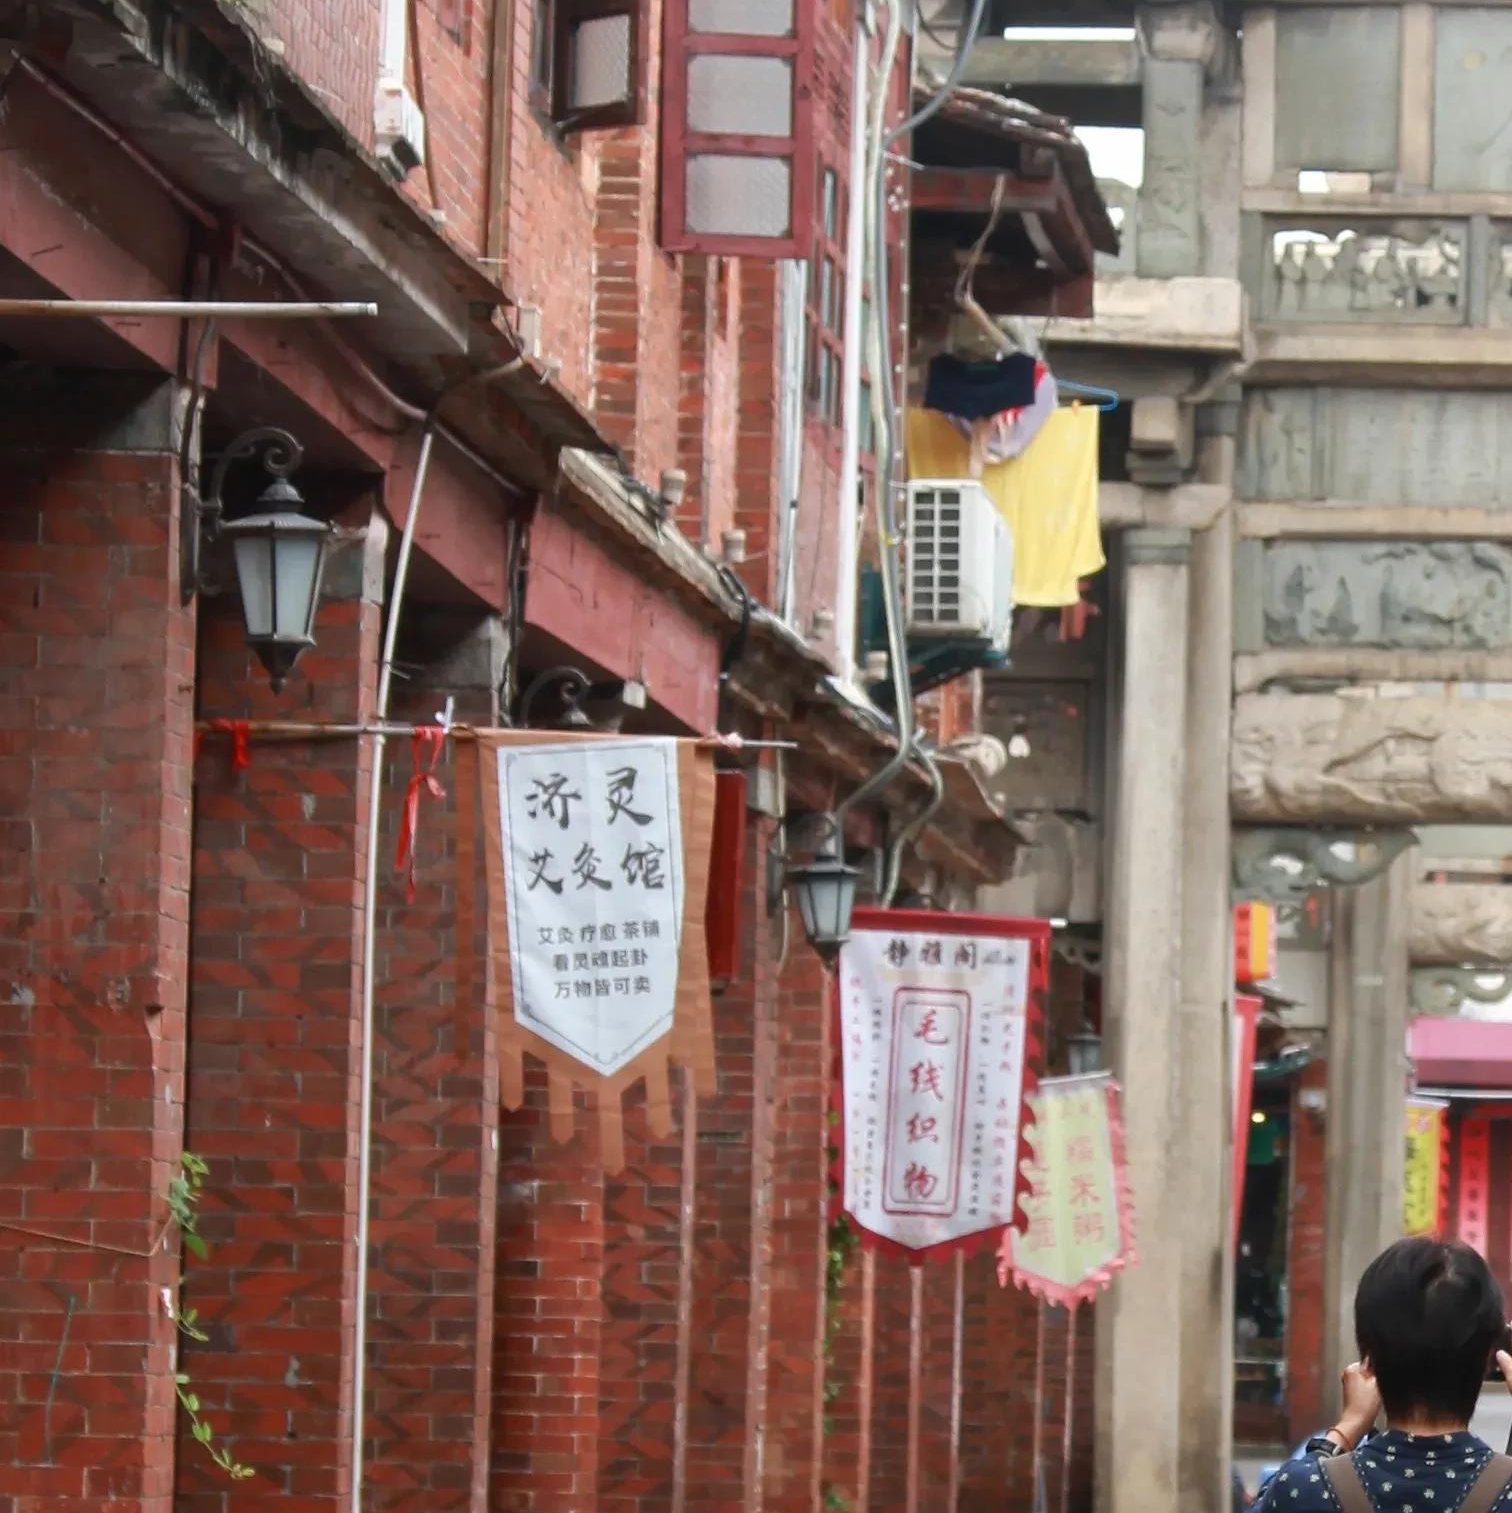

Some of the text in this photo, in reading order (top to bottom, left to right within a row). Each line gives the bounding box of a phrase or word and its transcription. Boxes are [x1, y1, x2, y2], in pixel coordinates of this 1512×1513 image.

[528, 842, 664, 895] 艾灸馆
[554, 975, 651, 999] 万物皆可卖
[903, 1009, 948, 1200] 毛线织物
